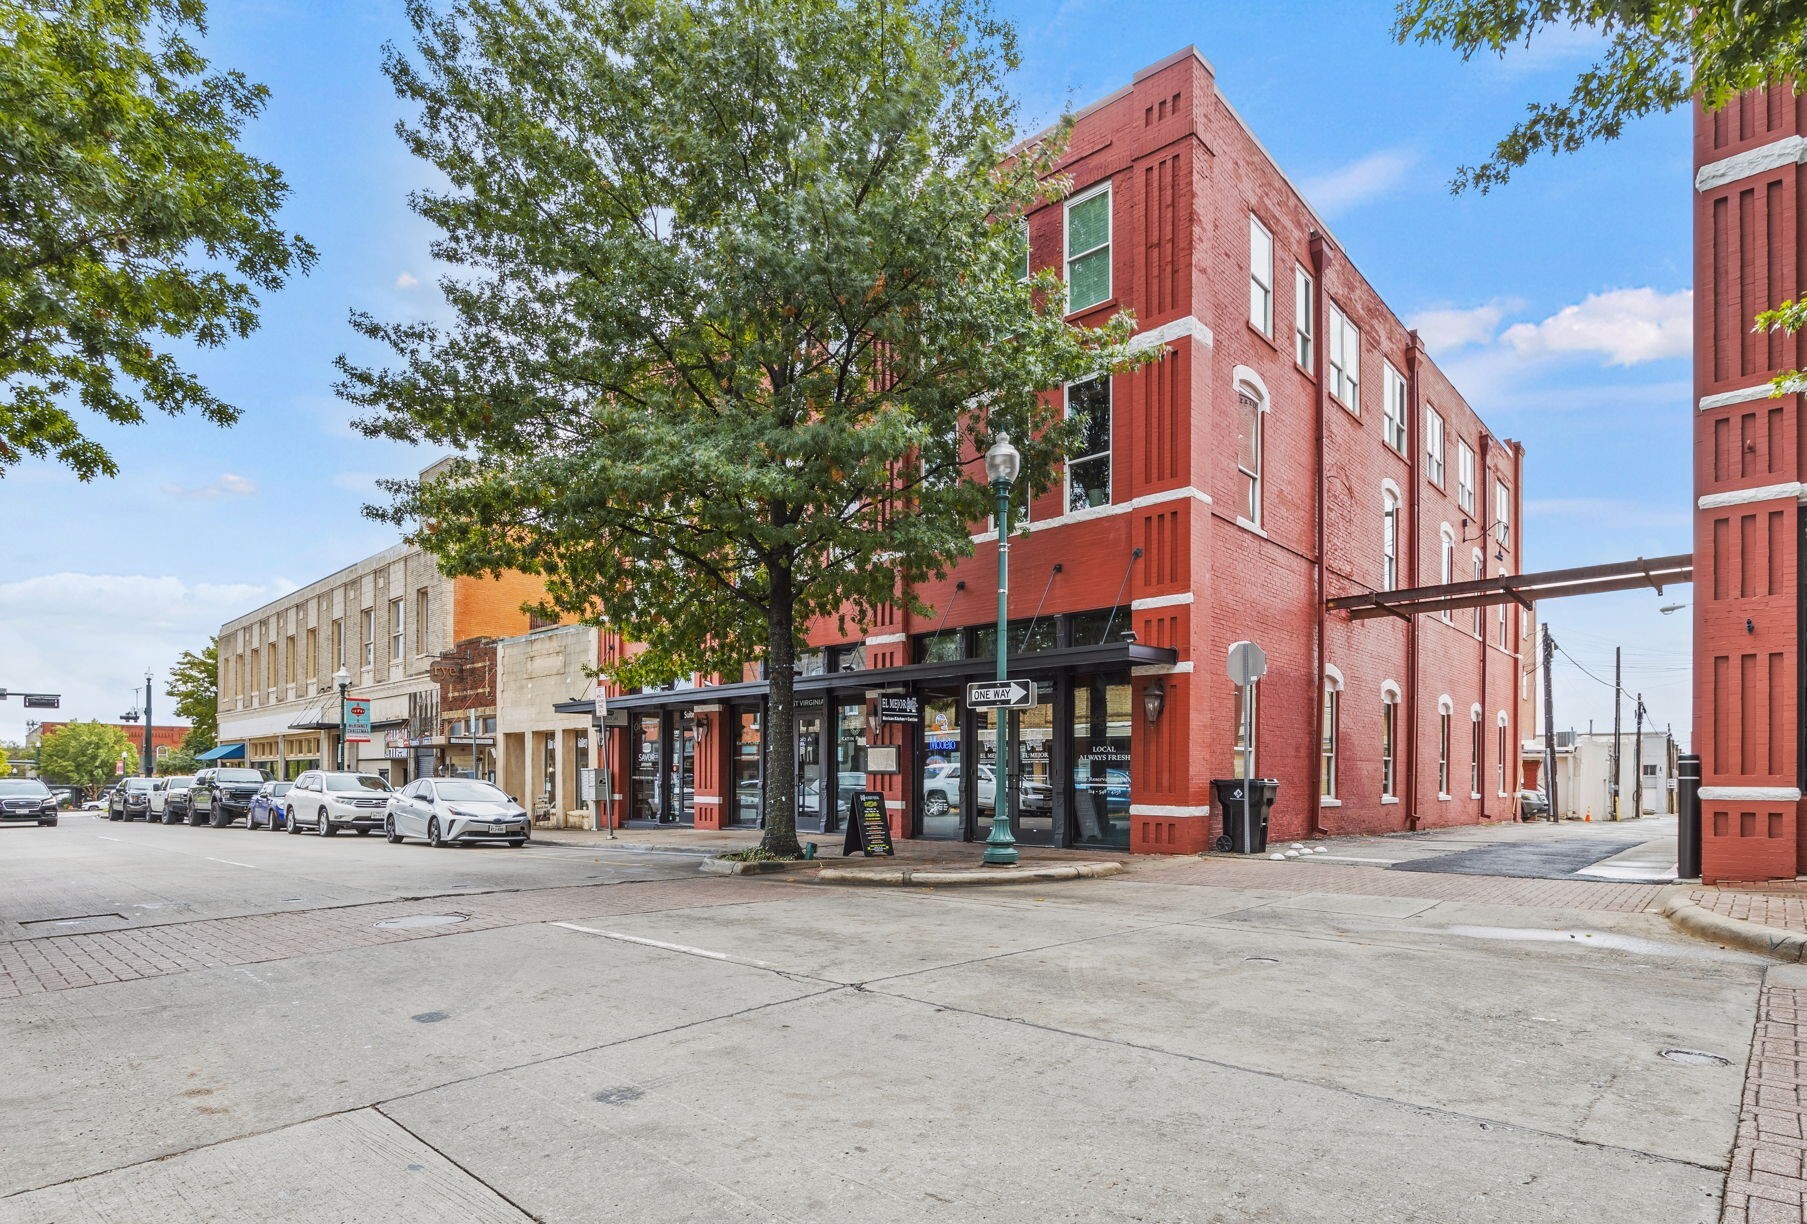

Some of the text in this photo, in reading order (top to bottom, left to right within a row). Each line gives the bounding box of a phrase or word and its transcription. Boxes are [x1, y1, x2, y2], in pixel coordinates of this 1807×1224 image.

[433, 666, 457, 679] rye
[974, 689, 1011, 700] ONE WAY
[882, 698, 888, 708] EL
[929, 736, 957, 750] Modelo
